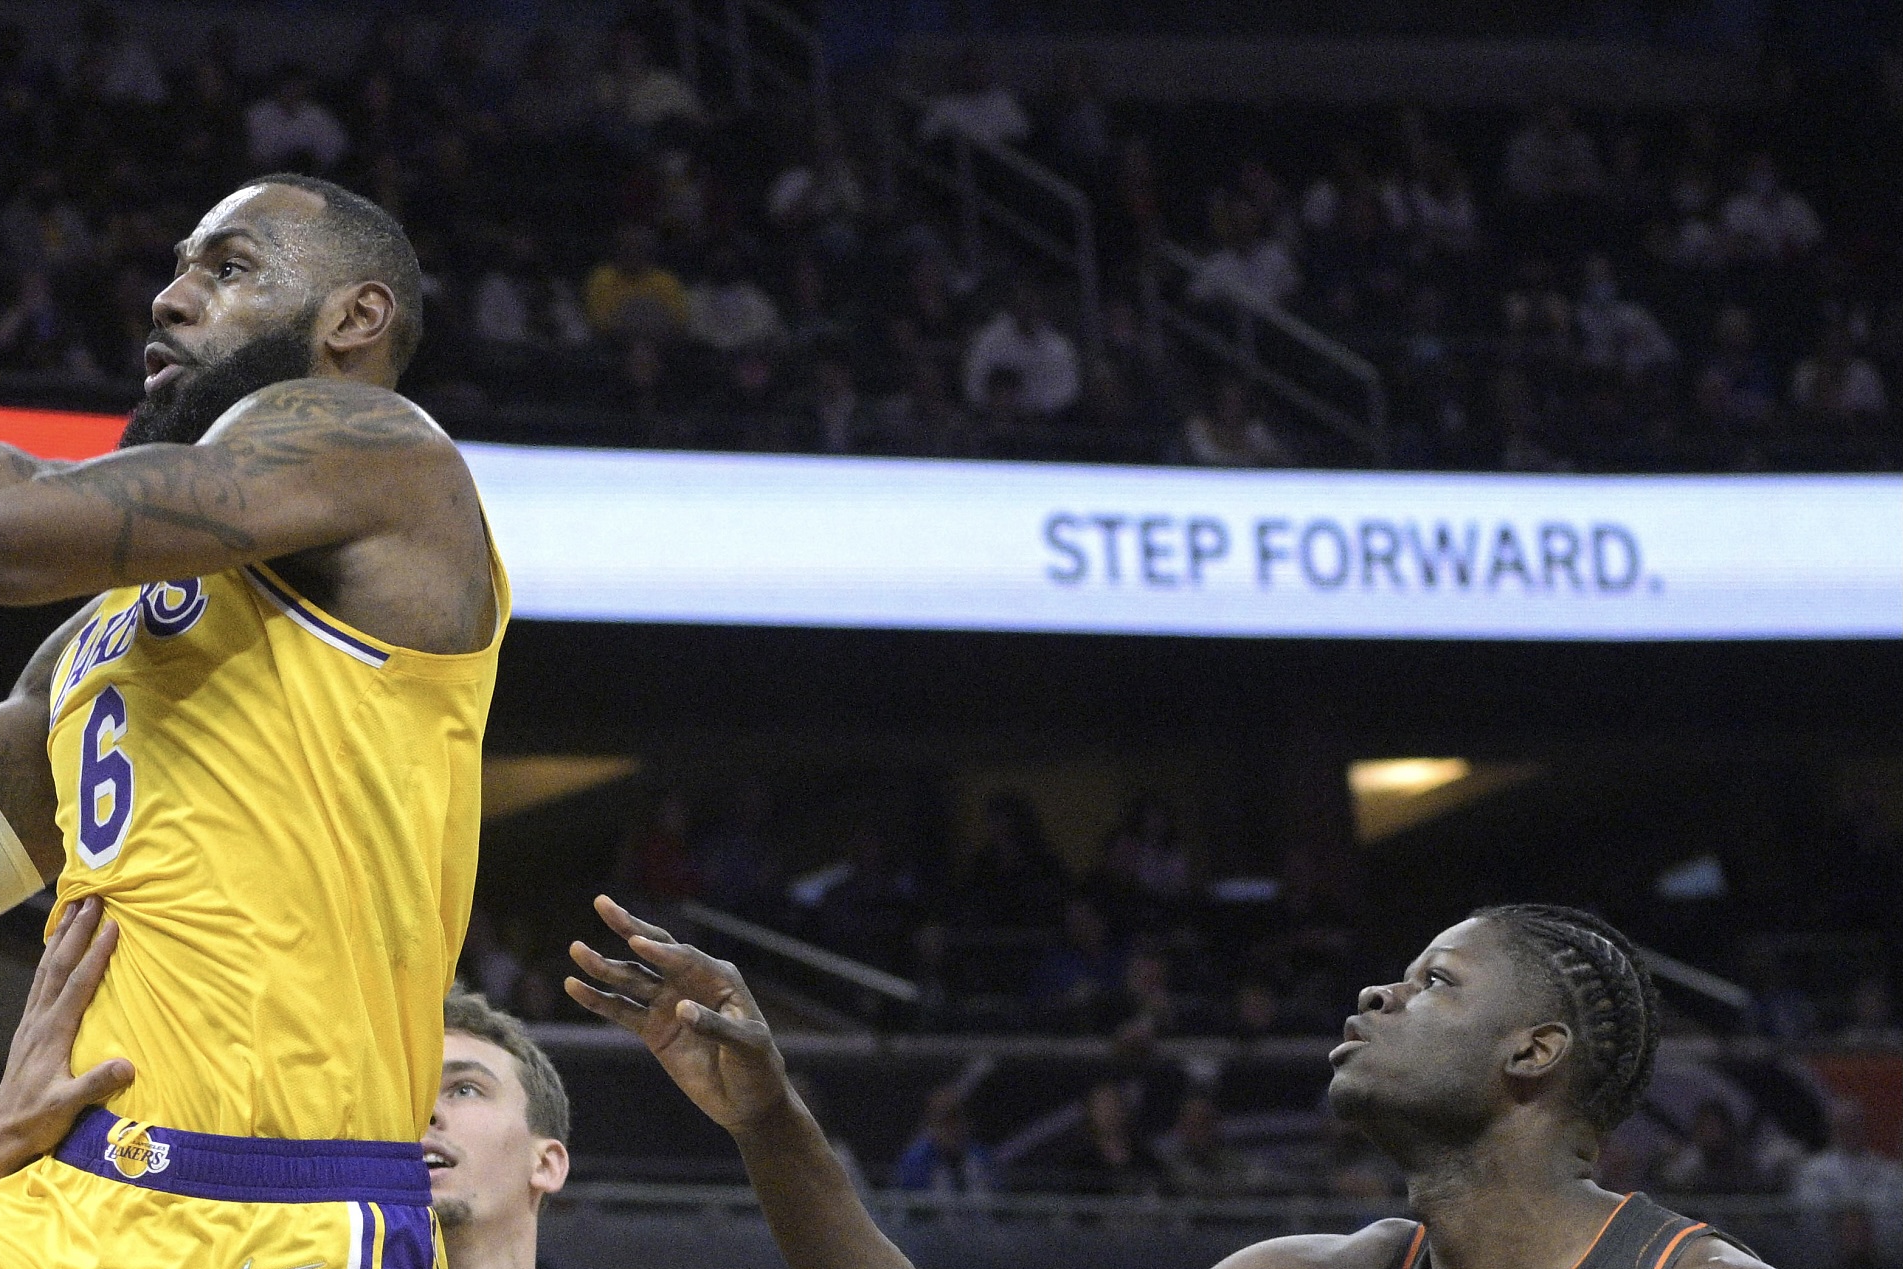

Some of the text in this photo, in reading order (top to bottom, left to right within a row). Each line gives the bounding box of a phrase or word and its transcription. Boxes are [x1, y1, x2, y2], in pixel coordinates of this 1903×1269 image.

[1043, 510, 1664, 595] STEP FORWARD.
[76, 684, 136, 870] 6
[106, 1145, 165, 1170] LAKERS
